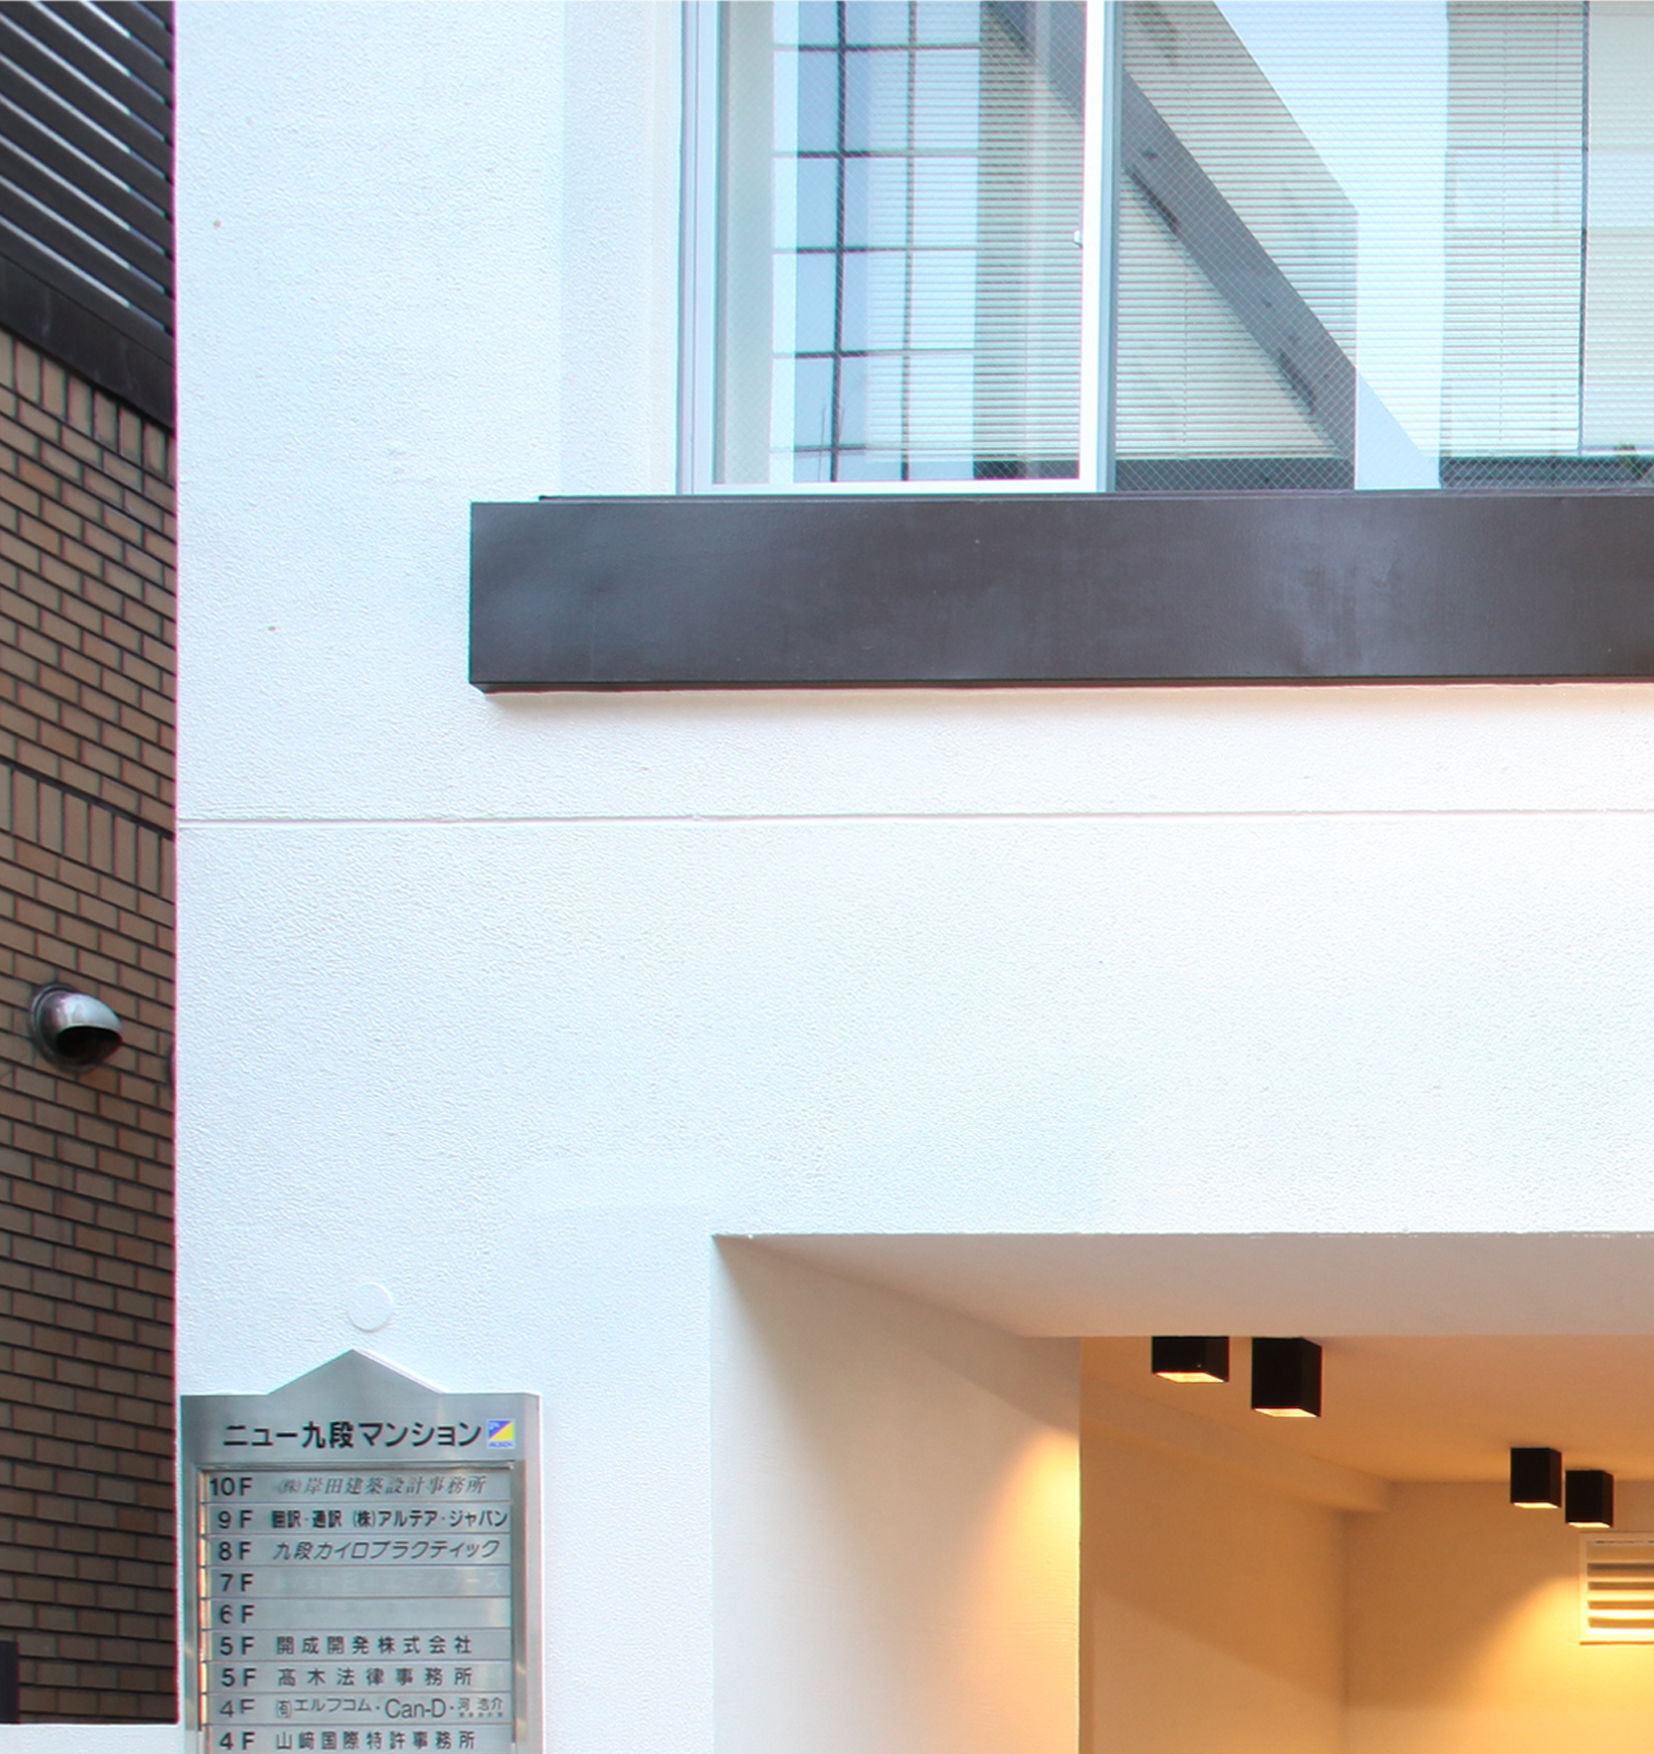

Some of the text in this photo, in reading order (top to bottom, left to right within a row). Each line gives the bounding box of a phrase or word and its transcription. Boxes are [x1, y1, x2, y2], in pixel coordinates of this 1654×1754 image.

[223, 1421, 482, 1448] ニュー九段マンション
